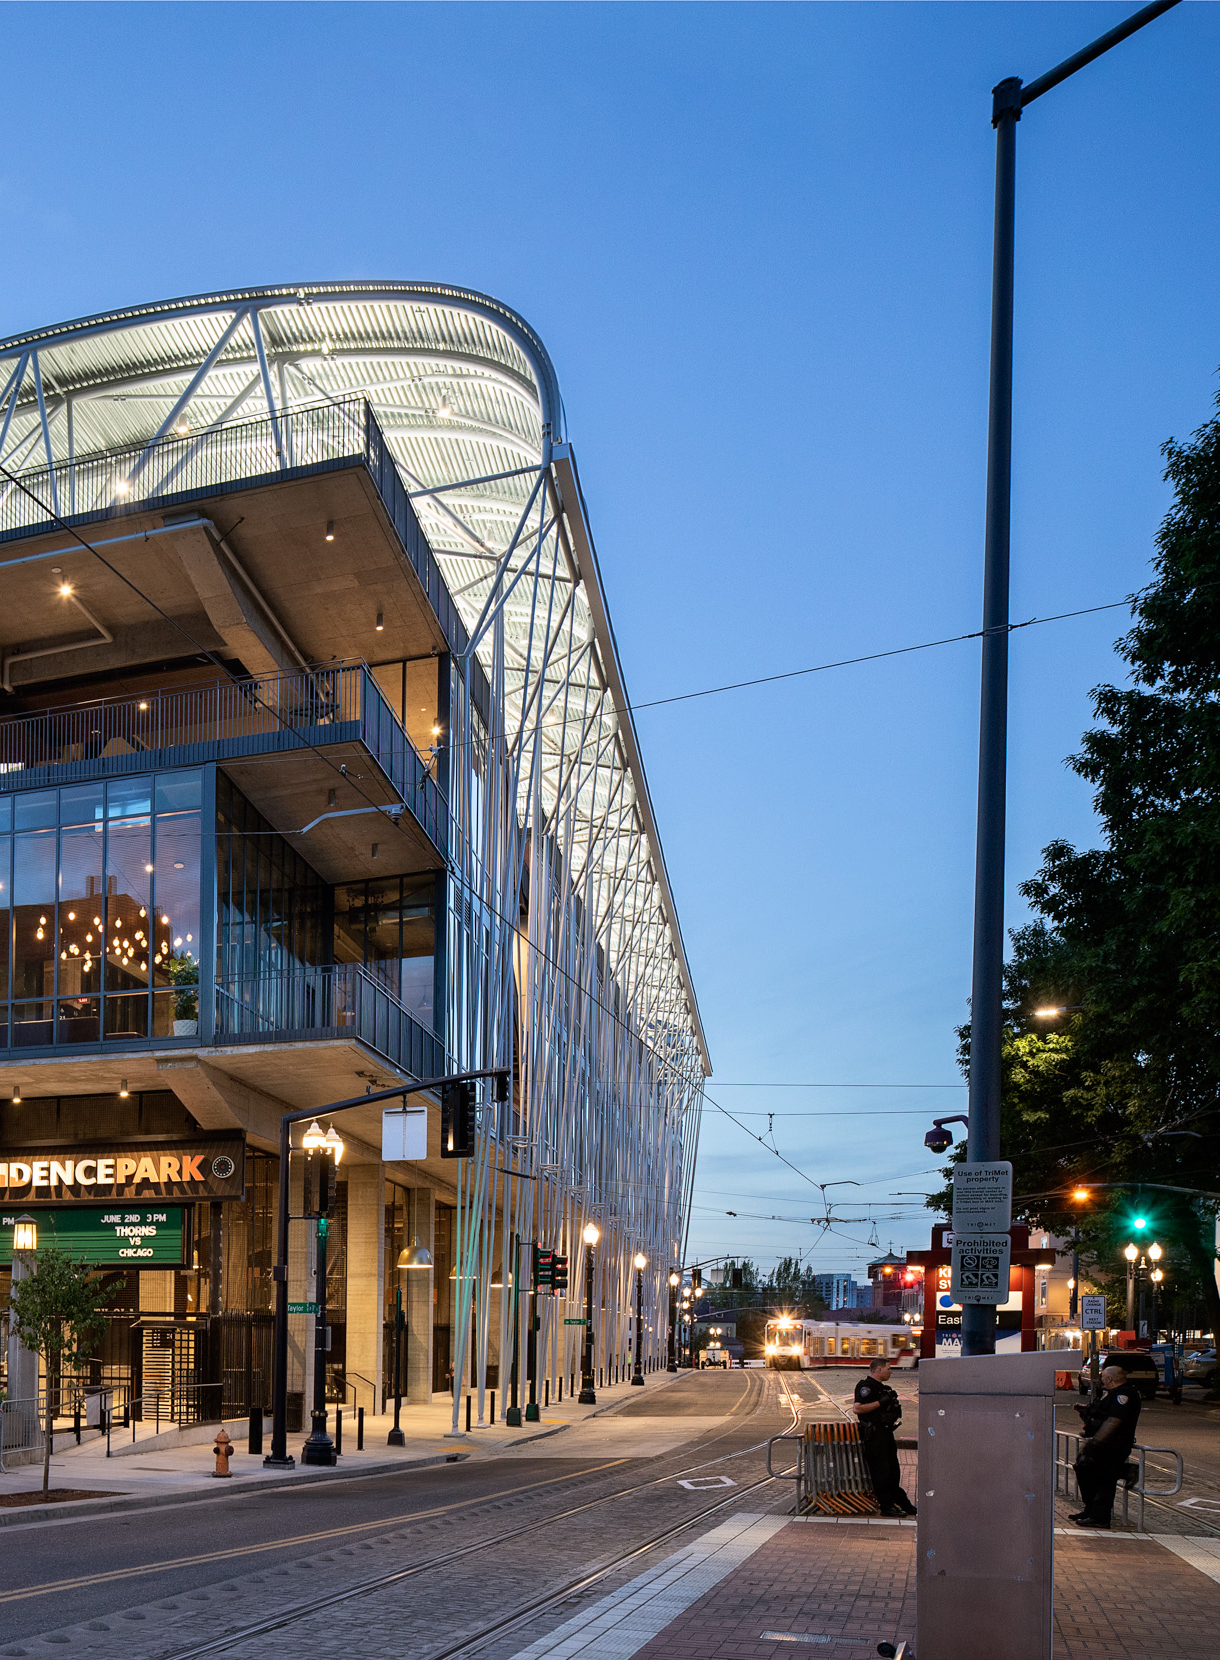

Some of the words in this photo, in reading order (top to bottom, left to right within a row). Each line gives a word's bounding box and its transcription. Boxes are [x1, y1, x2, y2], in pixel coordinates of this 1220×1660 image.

[2, 1217, 14, 1226] PM
[100, 1214, 122, 1223] JUNE
[124, 1214, 141, 1223] 2ND
[146, 1214, 152, 1222] 3
[153, 1214, 166, 1222] PM
[115, 1226, 157, 1237] THORNS
[129, 1237, 142, 1246] VS
[118, 1248, 154, 1257] CHICAGO
[288, 1304, 304, 1312] Taylor
[942, 1338, 962, 1346] MA
